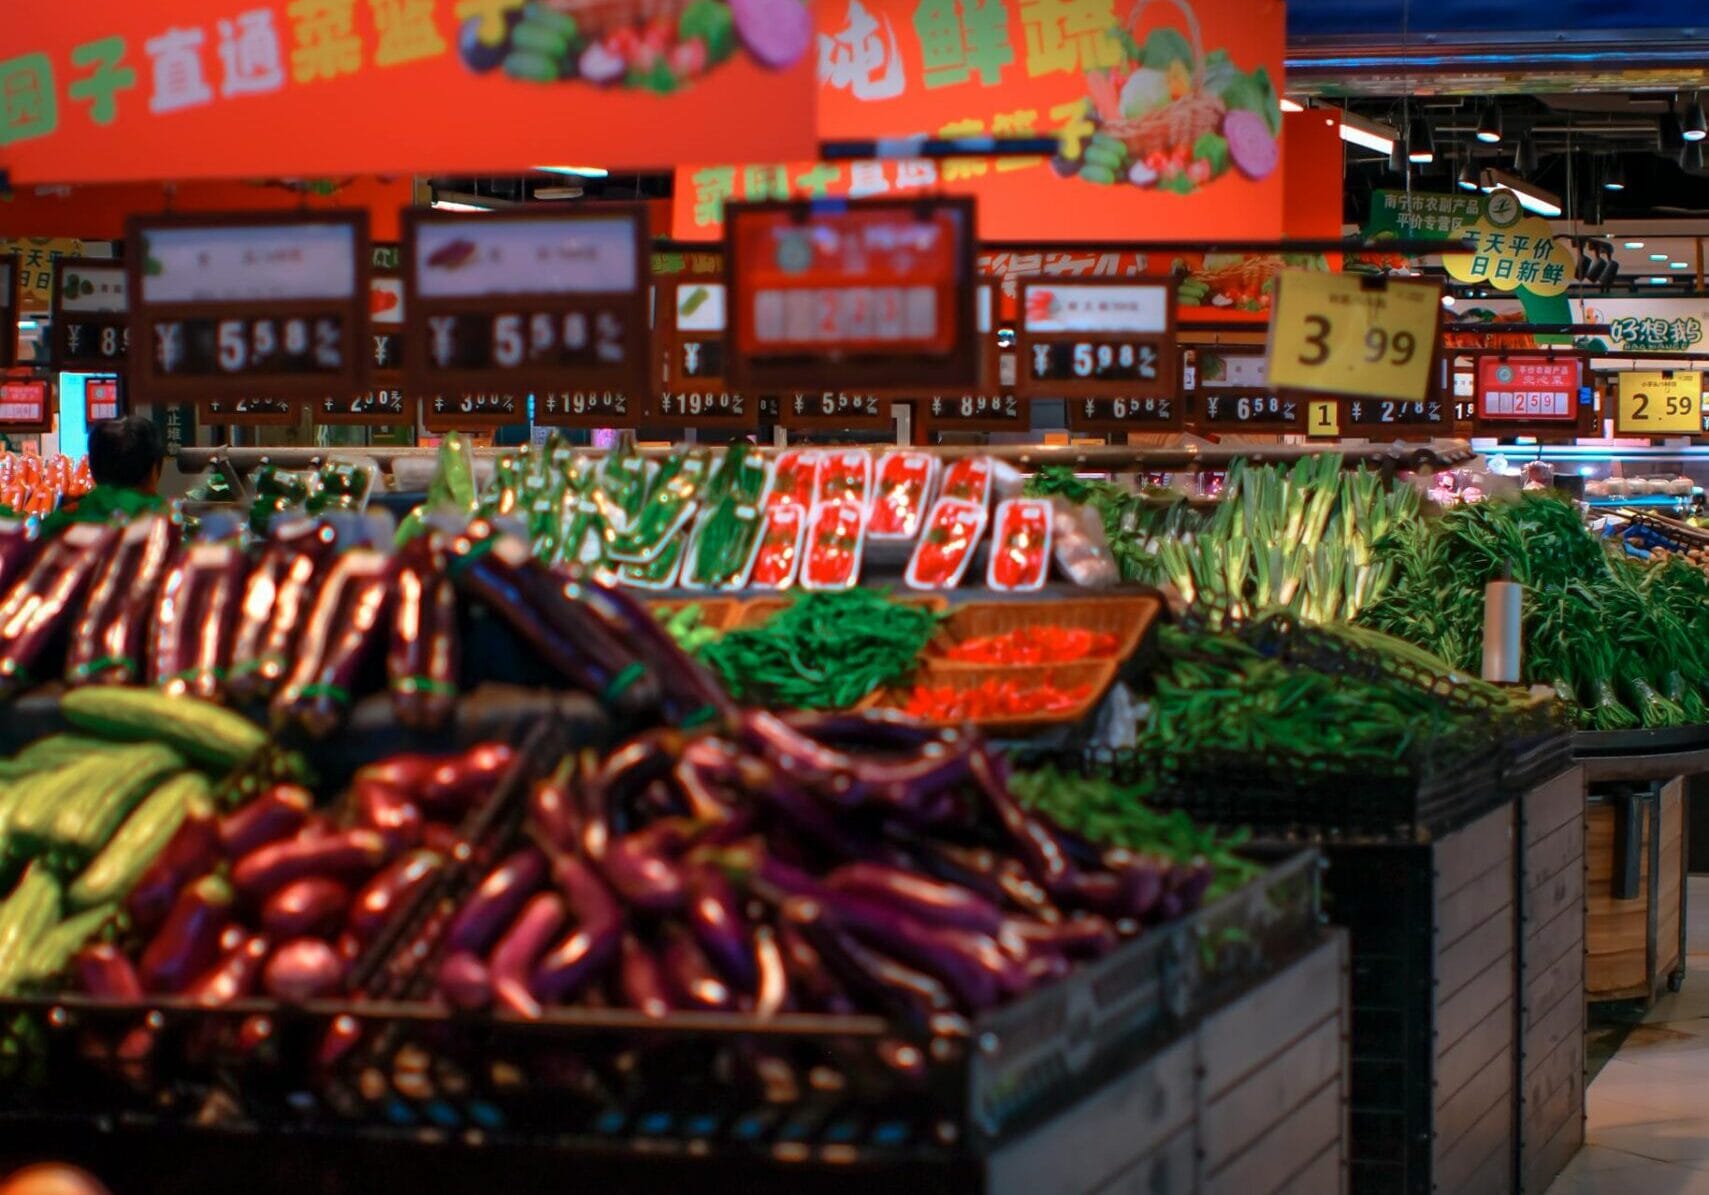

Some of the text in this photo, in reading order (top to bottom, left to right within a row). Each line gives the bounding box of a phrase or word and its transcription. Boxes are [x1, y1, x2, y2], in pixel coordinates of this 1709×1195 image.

[1384, 194, 1480, 216] 南宁市农副产品
[1397, 213, 1464, 231] 平价专营区
[1470, 256, 1565, 286] 日日新鲜
[677, 392, 729, 414] 19.80
[822, 392, 862, 414] 5.58
[961, 396, 1001, 416] 8.98
[1113, 396, 1155, 418] 6.58
[1237, 397, 1279, 420] 6.58
[1318, 404, 1331, 427] 1
